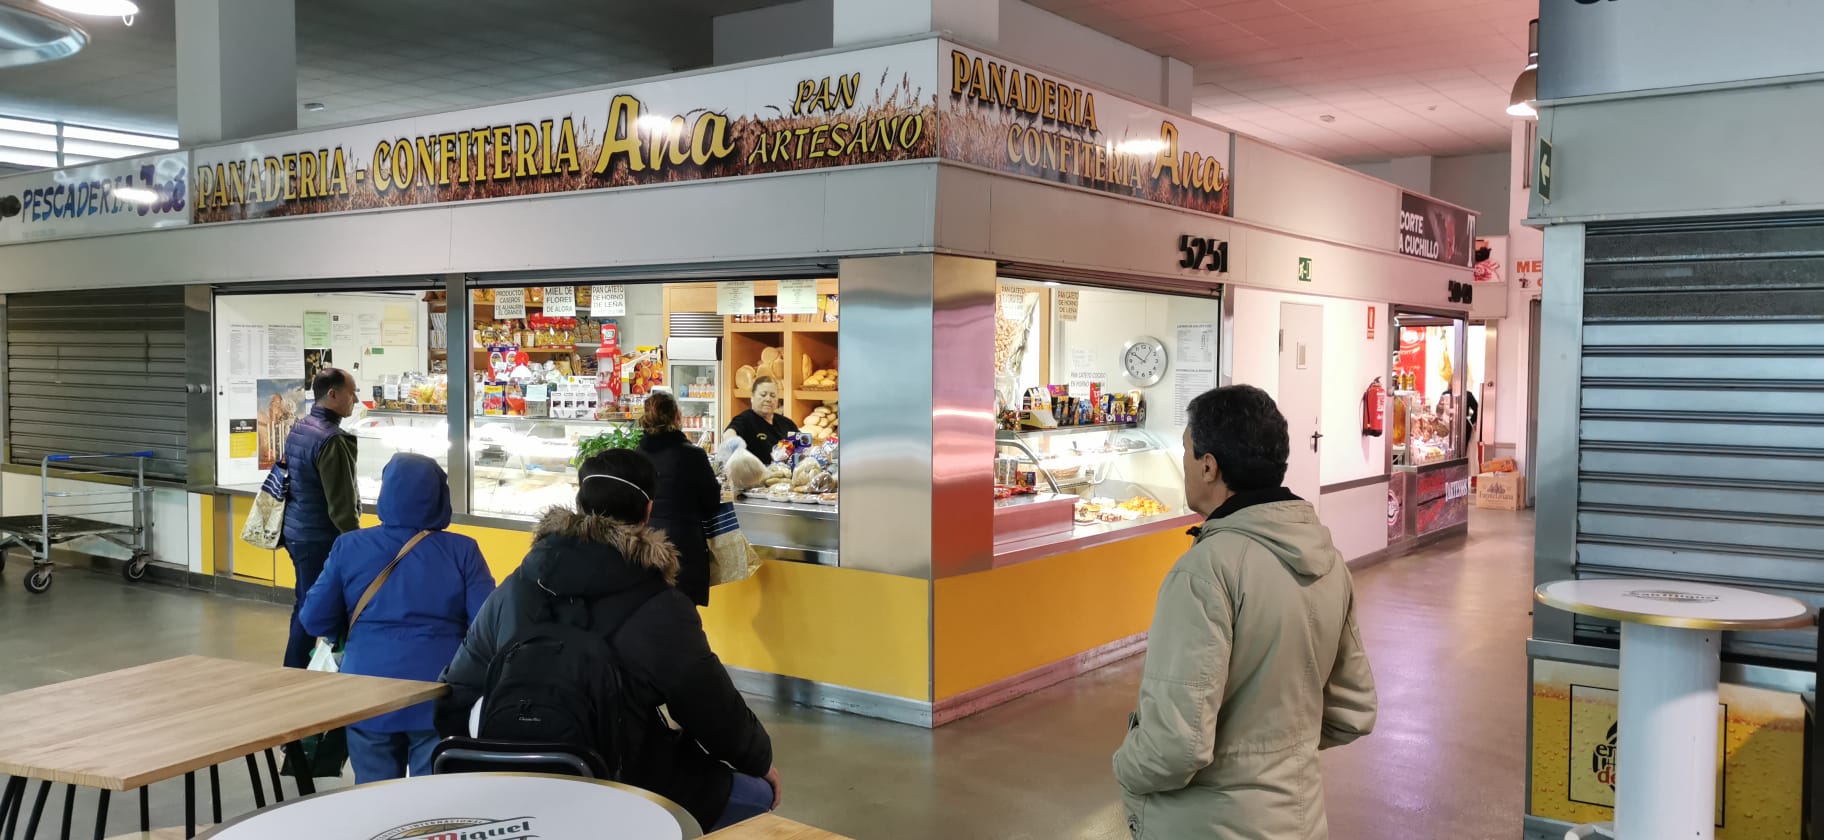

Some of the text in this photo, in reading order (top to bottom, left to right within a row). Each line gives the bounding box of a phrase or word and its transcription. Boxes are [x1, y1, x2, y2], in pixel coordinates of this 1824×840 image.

[792, 72, 862, 116] PAN
[951, 50, 1098, 132] PANADERIA
[197, 146, 349, 210] PANADERIA
[373, 115, 580, 192] CONFITERIA
[594, 94, 736, 176] Ana
[747, 113, 925, 164] ARTESANO
[1007, 121, 1224, 194] CONFITERIA Ana
[1400, 210, 1424, 234] CORTE
[1179, 234, 1228, 273] 5251
[1405, 236, 1439, 259] CUCHILLO
[545, 287, 573, 296] MIEL DE
[546, 296, 573, 304] FLORES
[604, 286, 624, 294] CATETO
